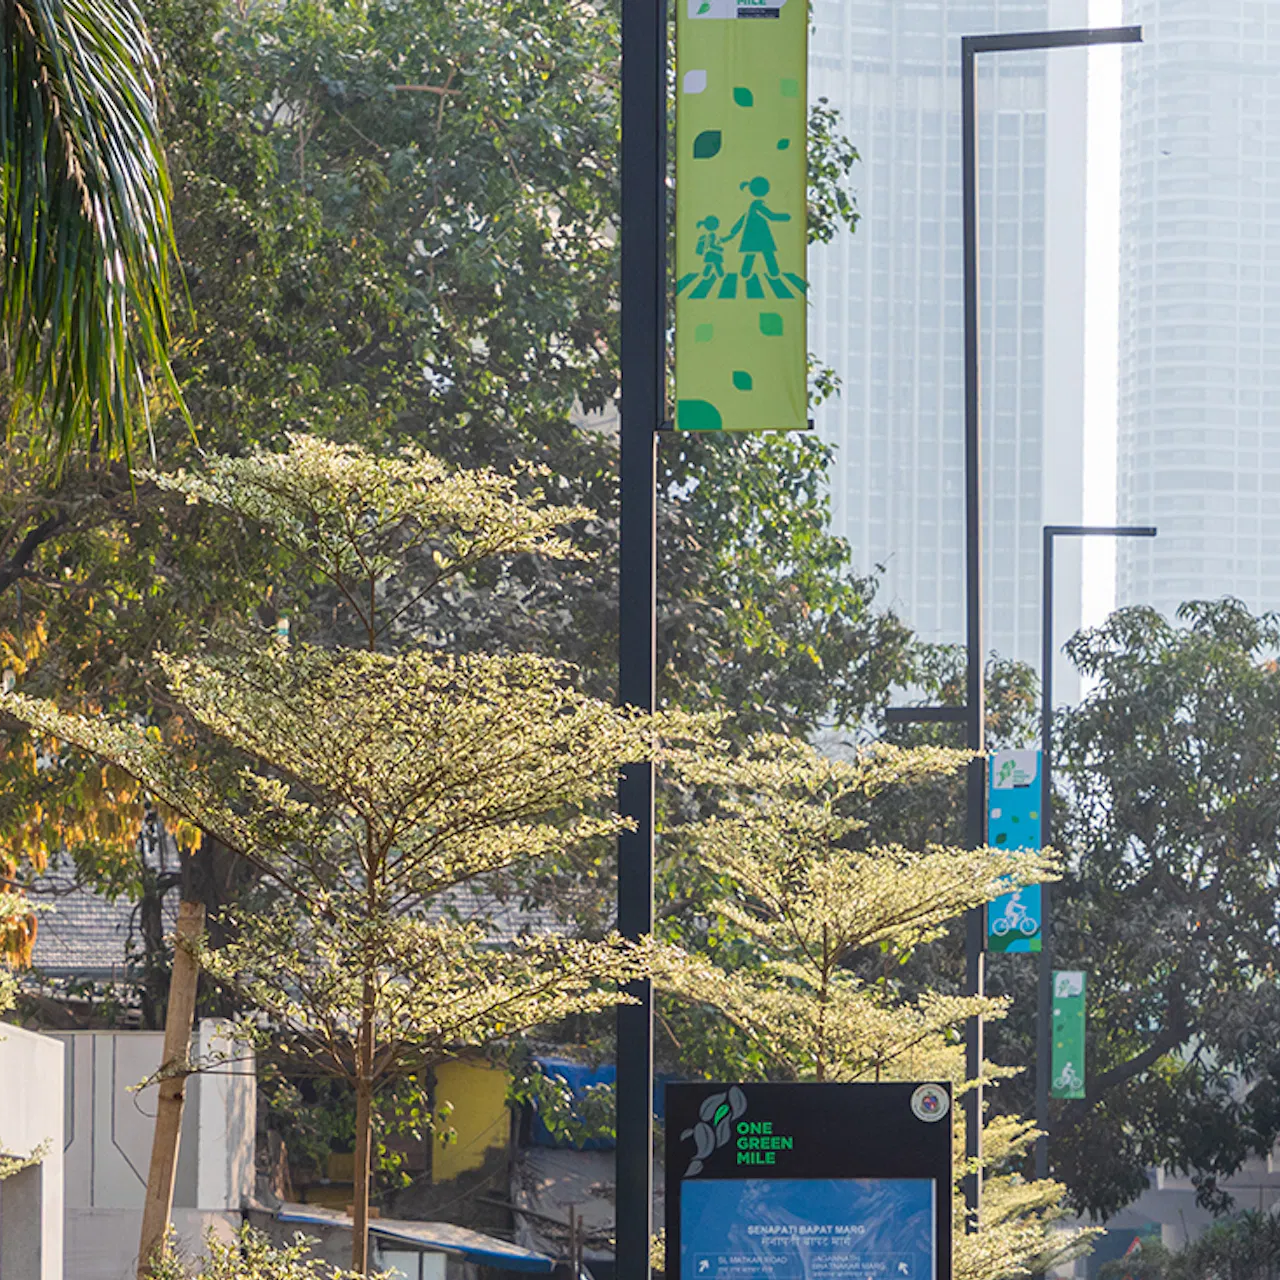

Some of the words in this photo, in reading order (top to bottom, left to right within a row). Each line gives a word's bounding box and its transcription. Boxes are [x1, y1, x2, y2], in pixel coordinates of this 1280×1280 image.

[737, 1121, 772, 1135] ONE
[737, 1136, 793, 1150] GREEN
[737, 1151, 776, 1165] MILE
[747, 1224, 798, 1236] SENAPATI
[798, 1224, 833, 1236] BAPAT
[834, 1224, 866, 1236] MARG
